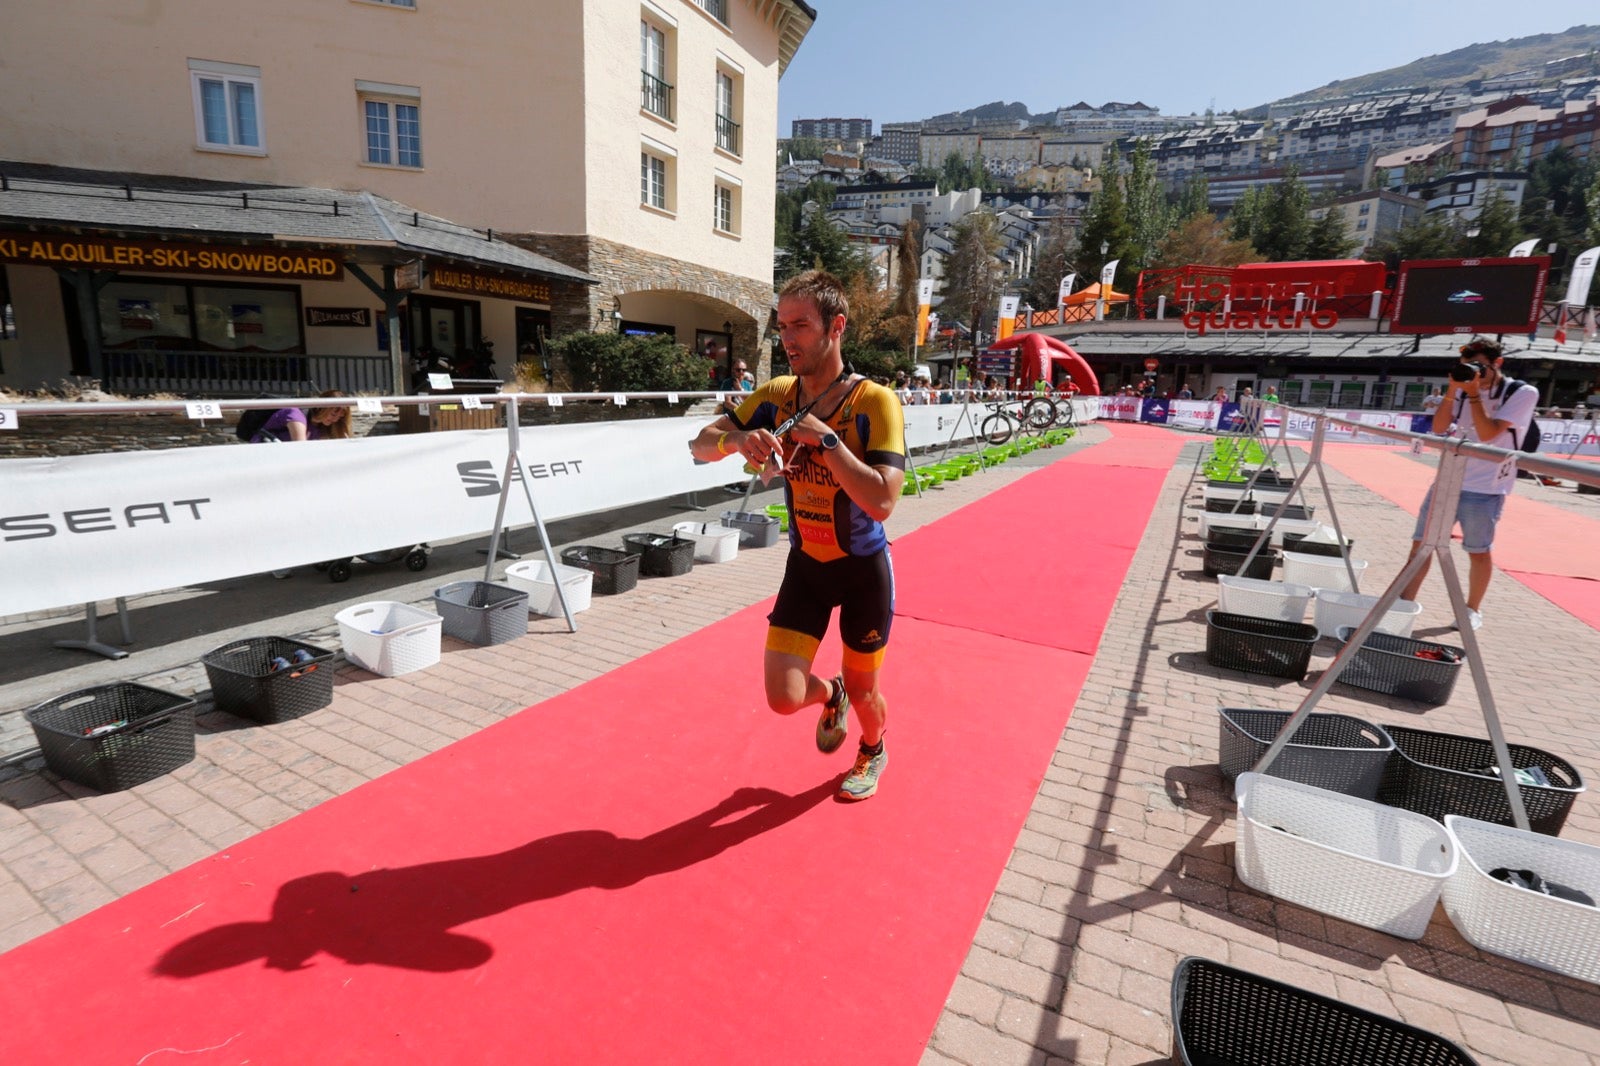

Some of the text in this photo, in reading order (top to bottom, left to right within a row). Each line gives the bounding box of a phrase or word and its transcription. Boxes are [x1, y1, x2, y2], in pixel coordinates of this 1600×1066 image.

[434, 269, 472, 289] ALQUILER
[1174, 272, 1357, 305] Home of
[1182, 307, 1339, 336] quattro
[196, 404, 214, 416] 38
[0, 498, 211, 542] SEAT
